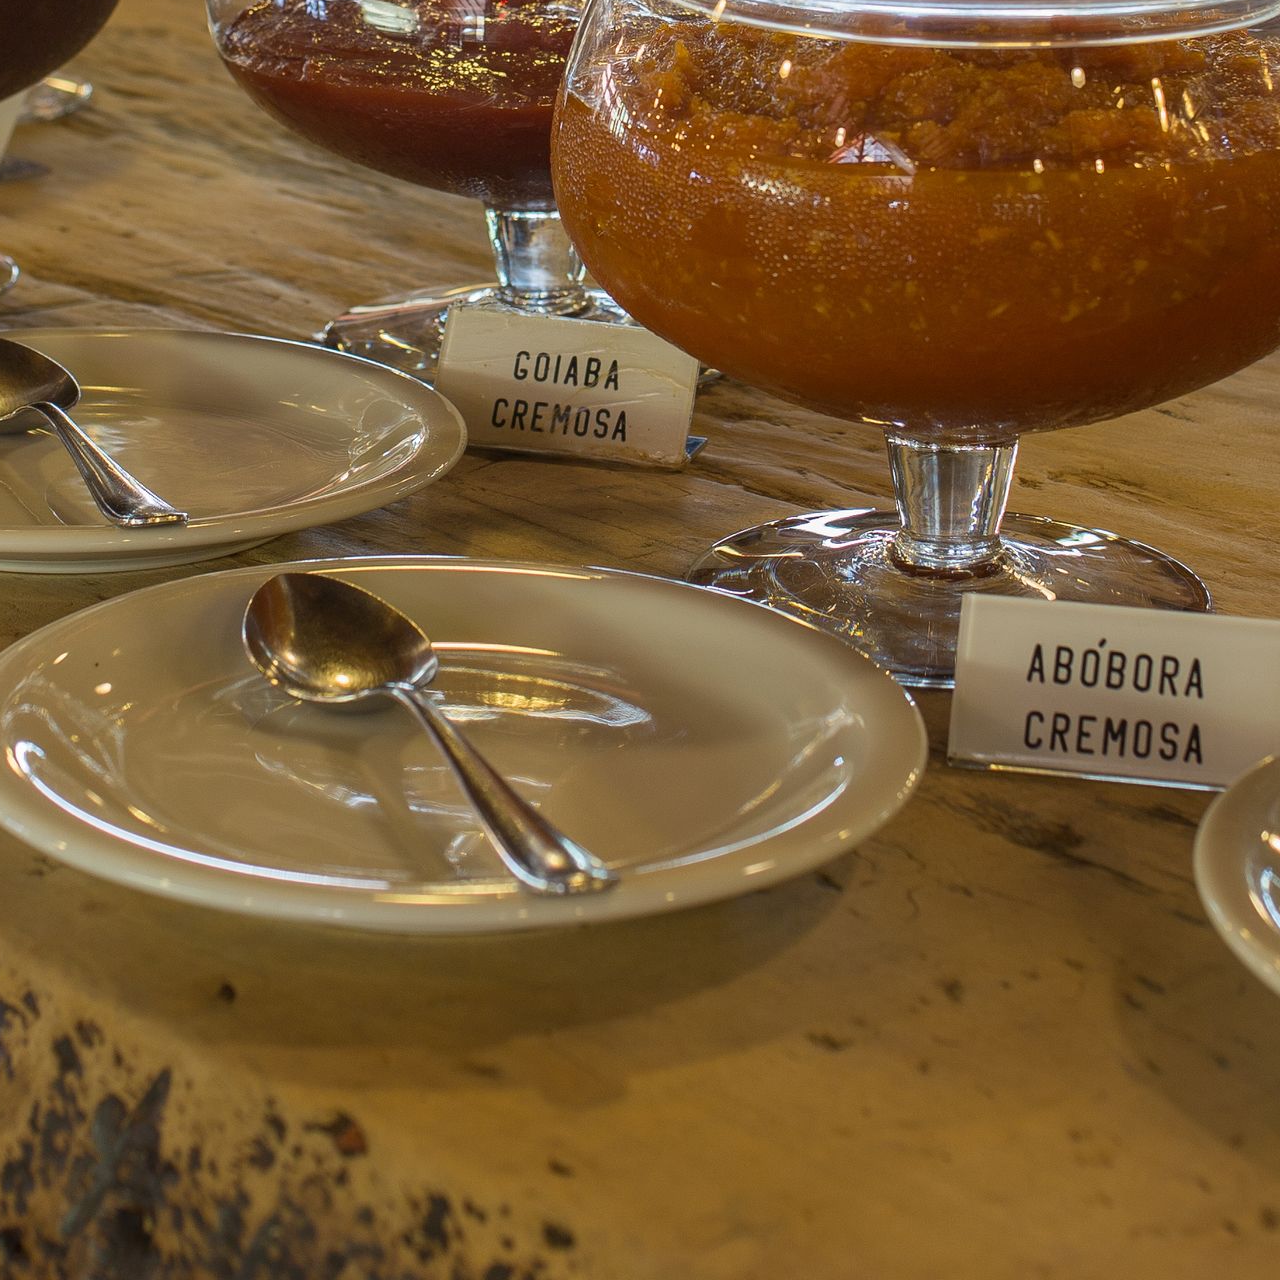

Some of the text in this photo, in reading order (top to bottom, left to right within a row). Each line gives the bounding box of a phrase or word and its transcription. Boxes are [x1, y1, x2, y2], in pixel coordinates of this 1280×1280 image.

[513, 350, 619, 391] GOIABA
[491, 398, 627, 442] CREMOSA
[1027, 638, 1204, 699] ABÓBORA
[1023, 711, 1203, 764] CREMOSA
